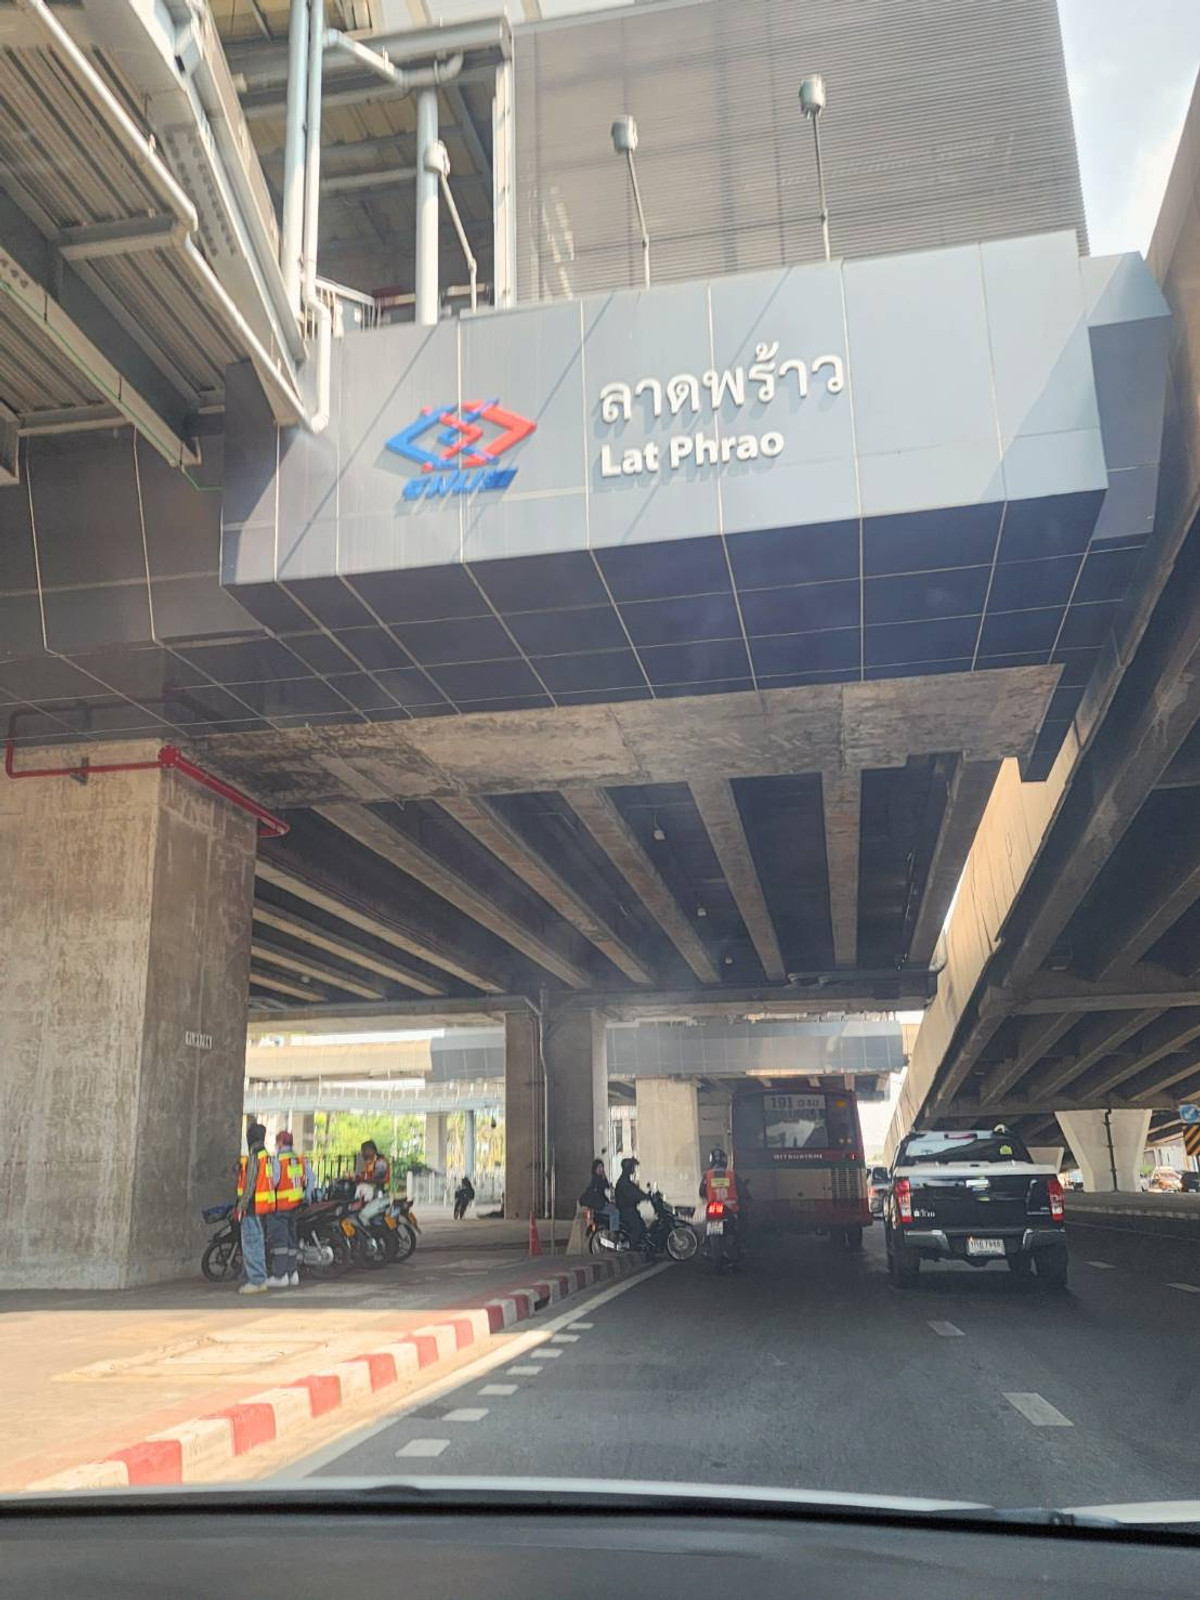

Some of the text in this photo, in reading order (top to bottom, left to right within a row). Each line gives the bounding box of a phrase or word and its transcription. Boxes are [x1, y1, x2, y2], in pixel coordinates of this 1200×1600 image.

[599, 340, 845, 423] ลาดพร้าว
[600, 431, 785, 478] Lat Phrao
